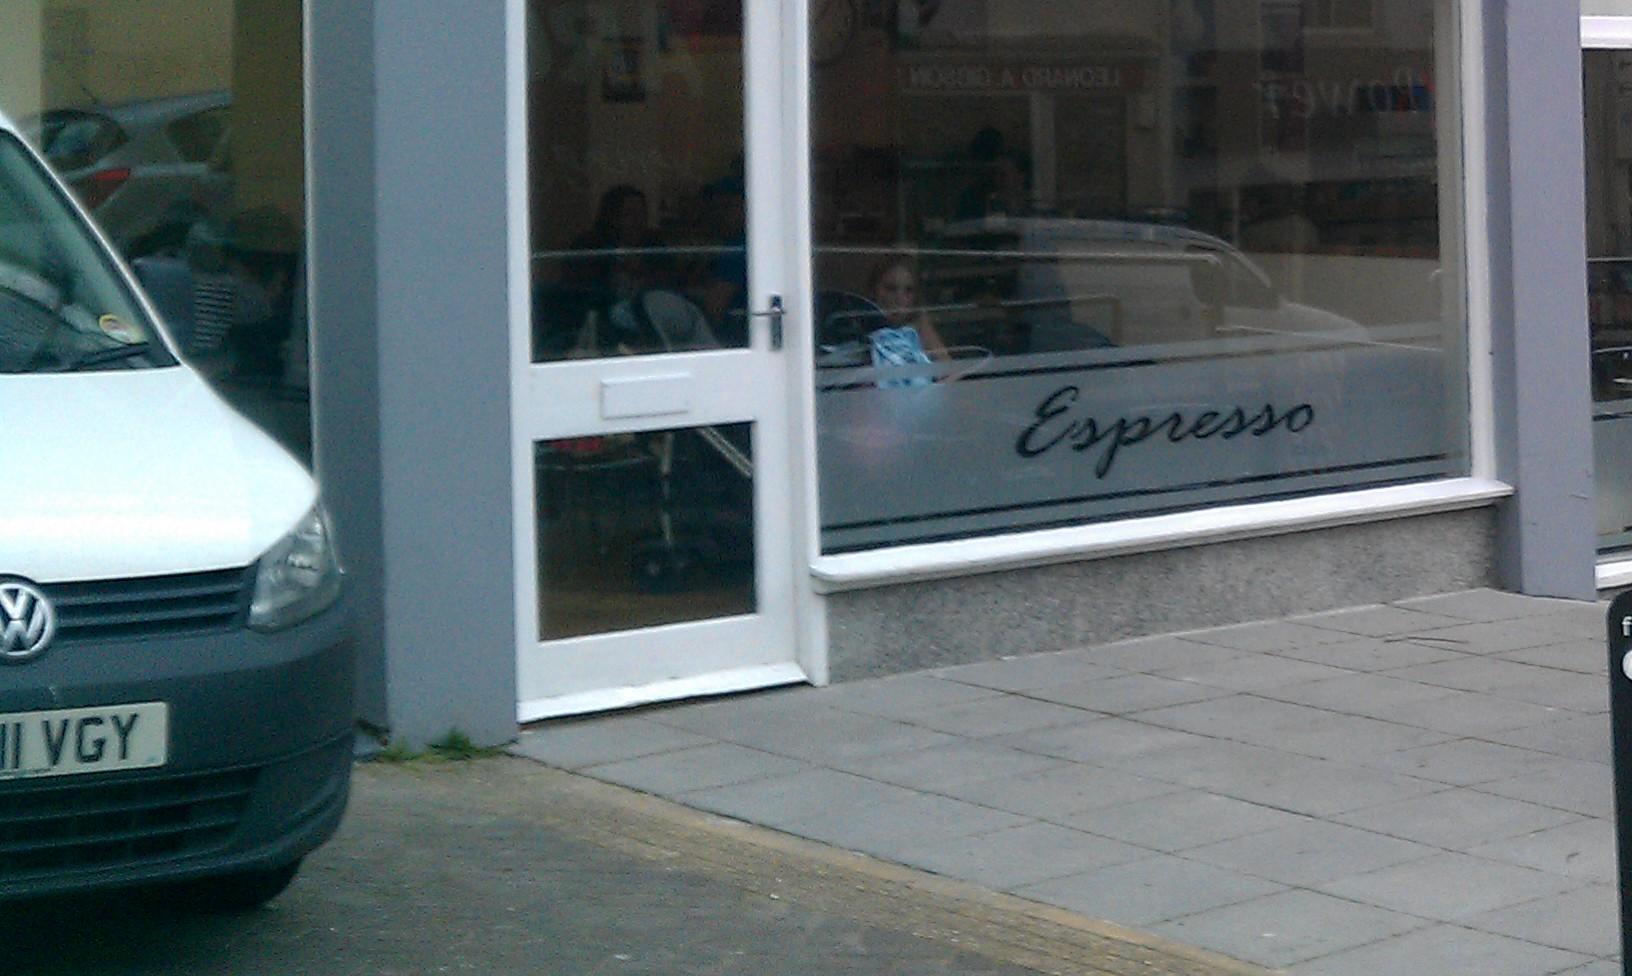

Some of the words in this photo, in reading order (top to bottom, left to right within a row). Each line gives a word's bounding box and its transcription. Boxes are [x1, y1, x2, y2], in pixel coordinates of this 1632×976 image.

[1015, 385, 1315, 478] Espresso
[0, 722, 22, 769] 11
[43, 713, 138, 766] VGY
